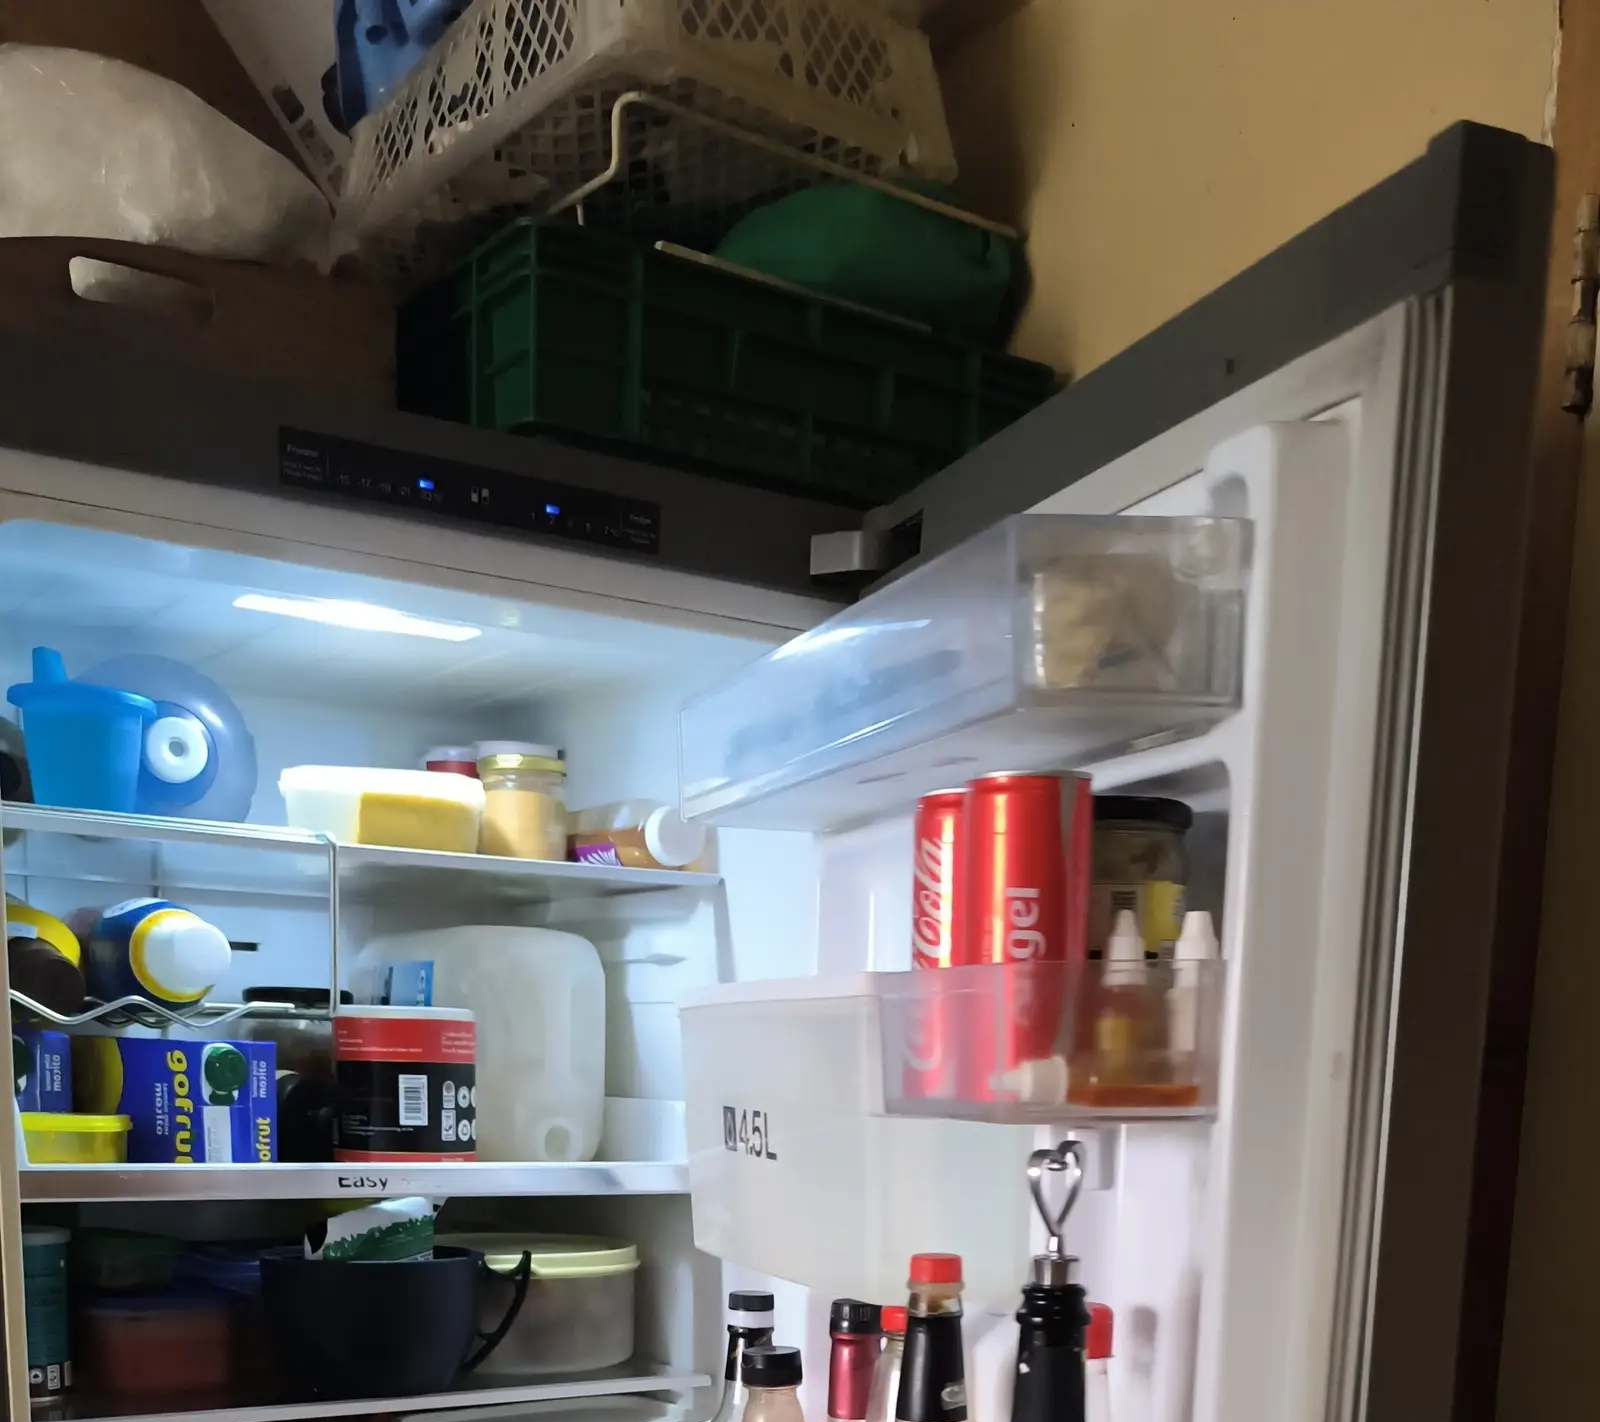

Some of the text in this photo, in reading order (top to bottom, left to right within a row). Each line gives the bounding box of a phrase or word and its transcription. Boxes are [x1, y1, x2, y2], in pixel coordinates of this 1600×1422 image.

[258, 1060, 268, 1099] mojito
[154, 1082, 164, 1136] mojito
[255, 1117, 272, 1164] ofrut
[338, 1176, 388, 1191] Easy
